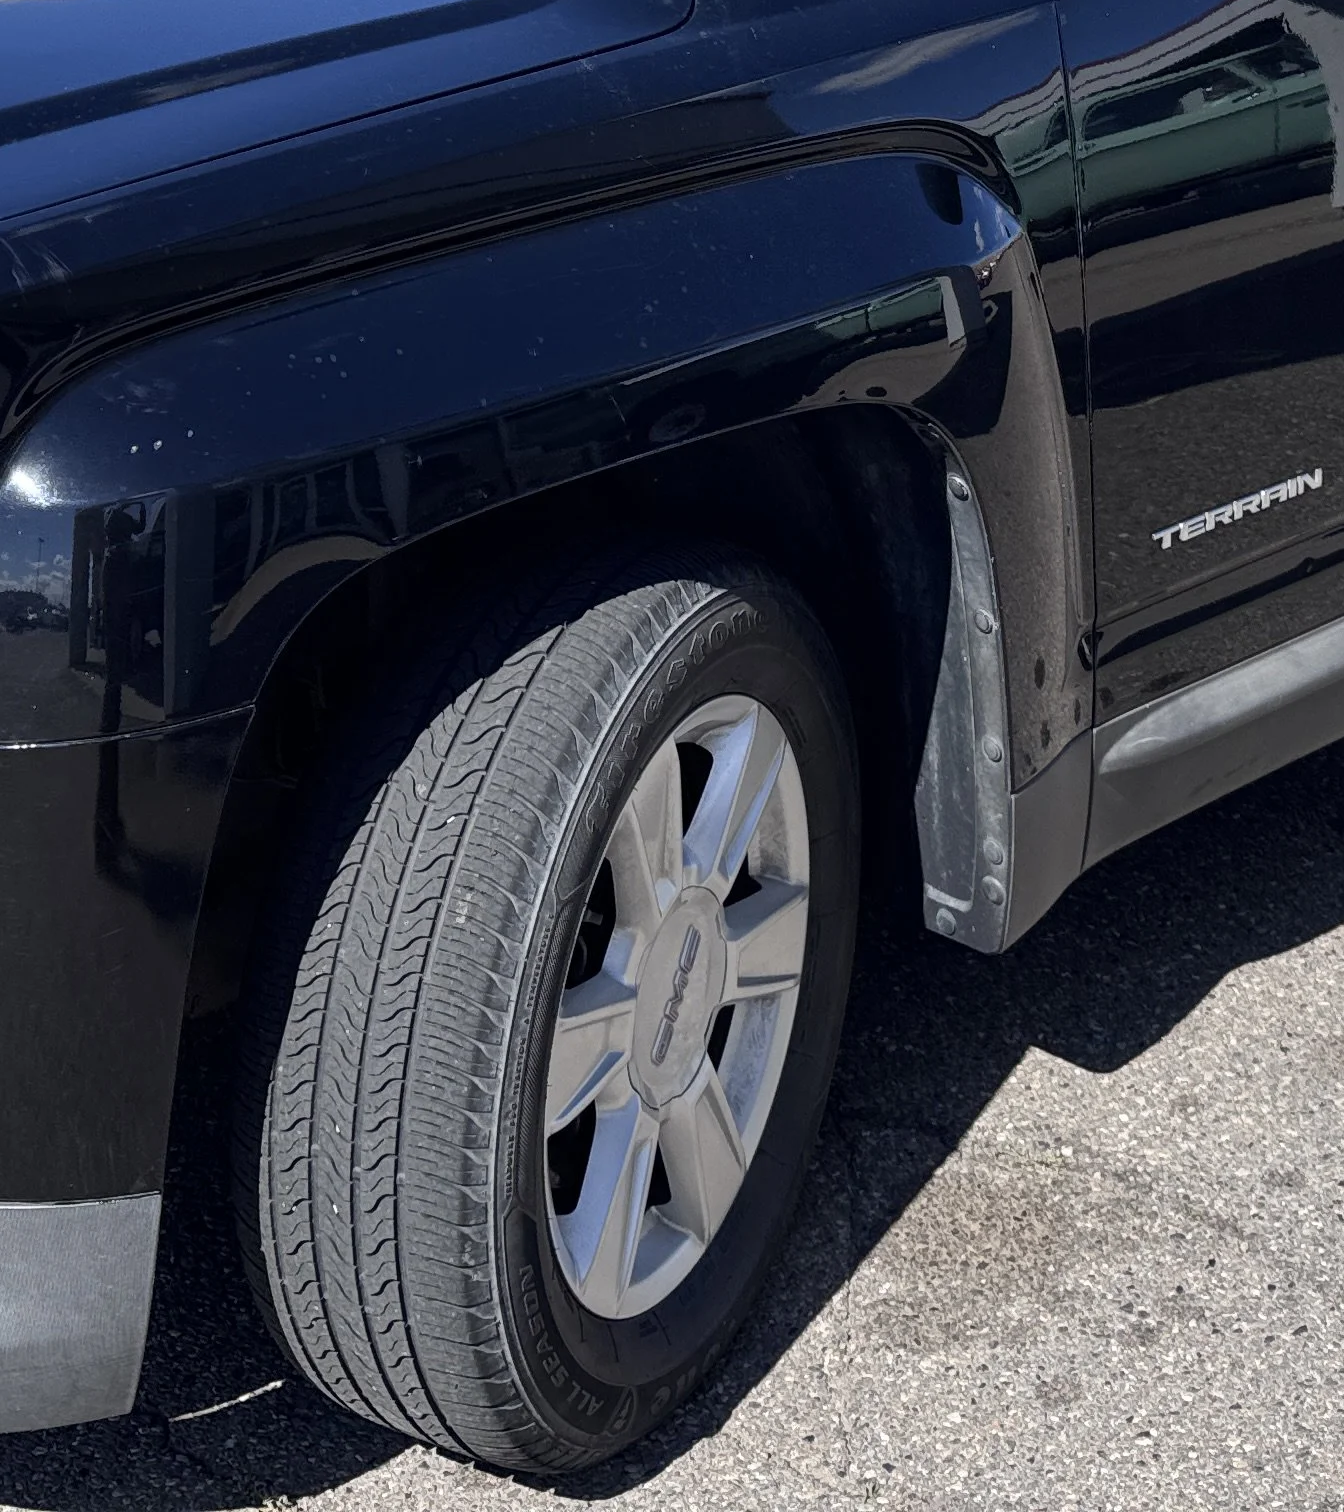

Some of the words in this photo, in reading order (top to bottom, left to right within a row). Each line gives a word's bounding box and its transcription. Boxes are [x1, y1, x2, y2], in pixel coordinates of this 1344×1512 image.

[1152, 467, 1323, 550] TERRAIN
[651, 924, 701, 1067] GMC
[519, 1263, 571, 1387] SEASON
[567, 1381, 605, 1416] ALL
